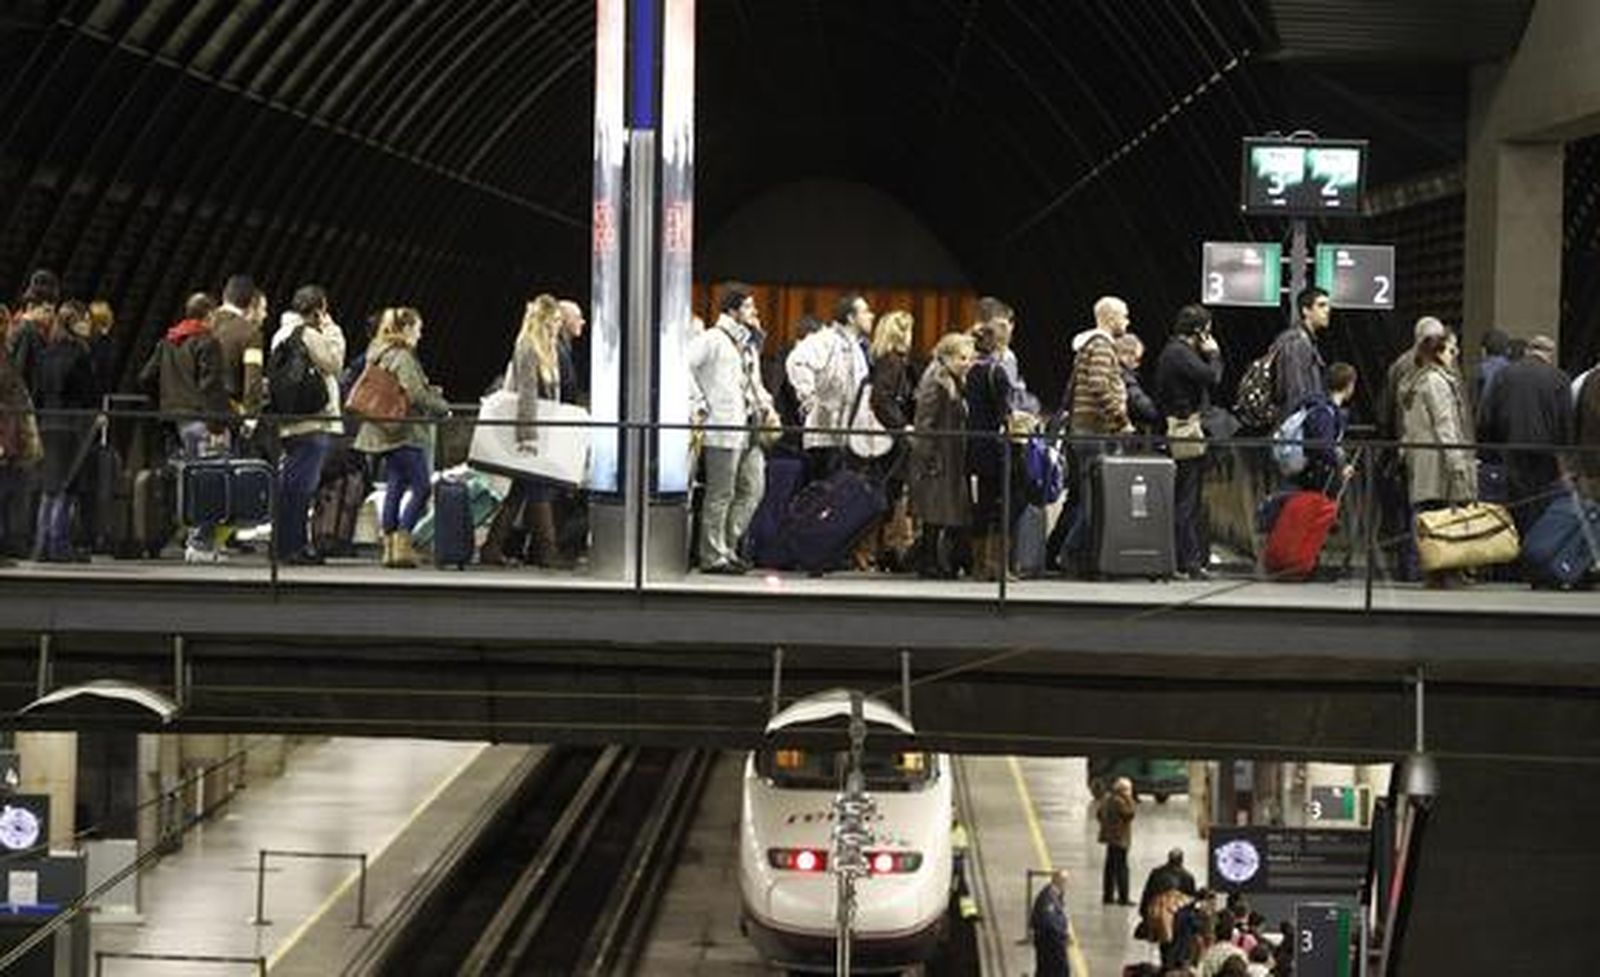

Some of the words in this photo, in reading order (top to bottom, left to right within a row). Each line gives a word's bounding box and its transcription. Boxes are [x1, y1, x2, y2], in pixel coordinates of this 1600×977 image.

[1267, 174, 1286, 195] 3
[1321, 175, 1339, 196] 2
[1208, 272, 1224, 301] 3
[1373, 276, 1390, 304] 2
[1309, 801, 1323, 820] 3
[1301, 931, 1313, 952] 3
